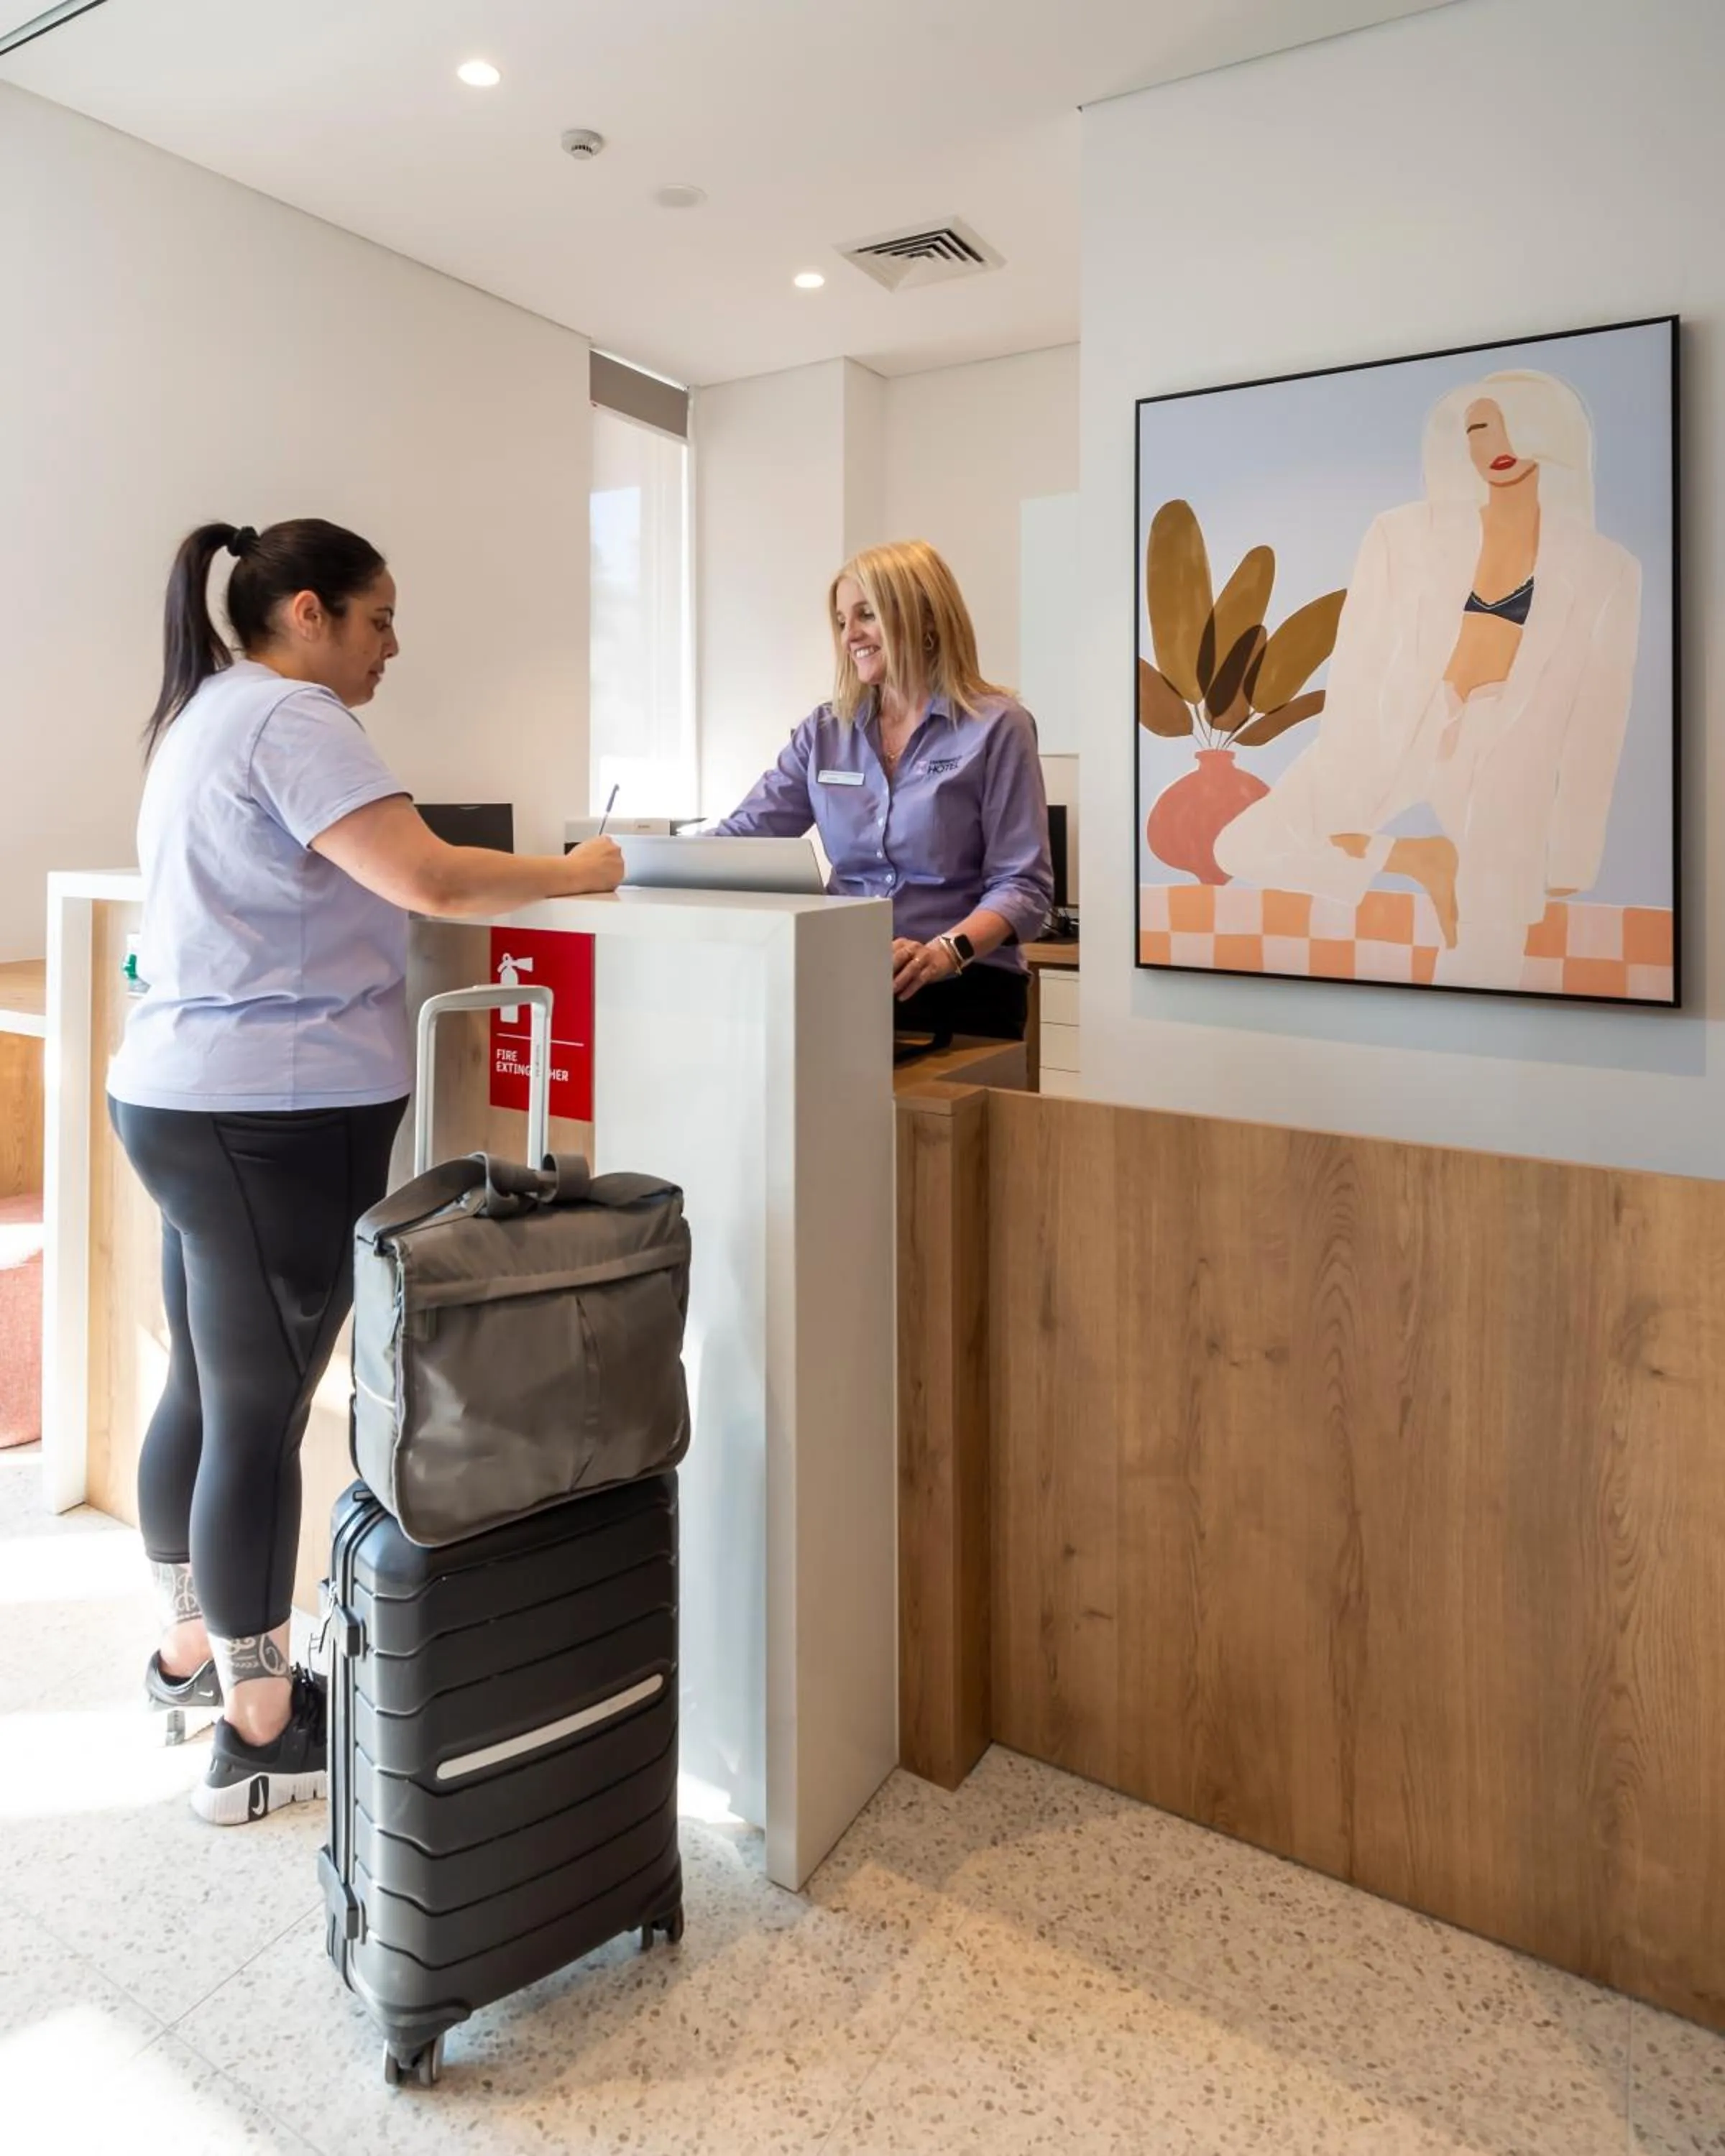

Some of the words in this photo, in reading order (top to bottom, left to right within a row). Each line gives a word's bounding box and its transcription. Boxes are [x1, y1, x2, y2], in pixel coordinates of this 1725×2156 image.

[928, 763, 958, 774] HOTEL
[497, 1049, 518, 1061] FIRE
[496, 1061, 569, 1082] EXTINGHER
